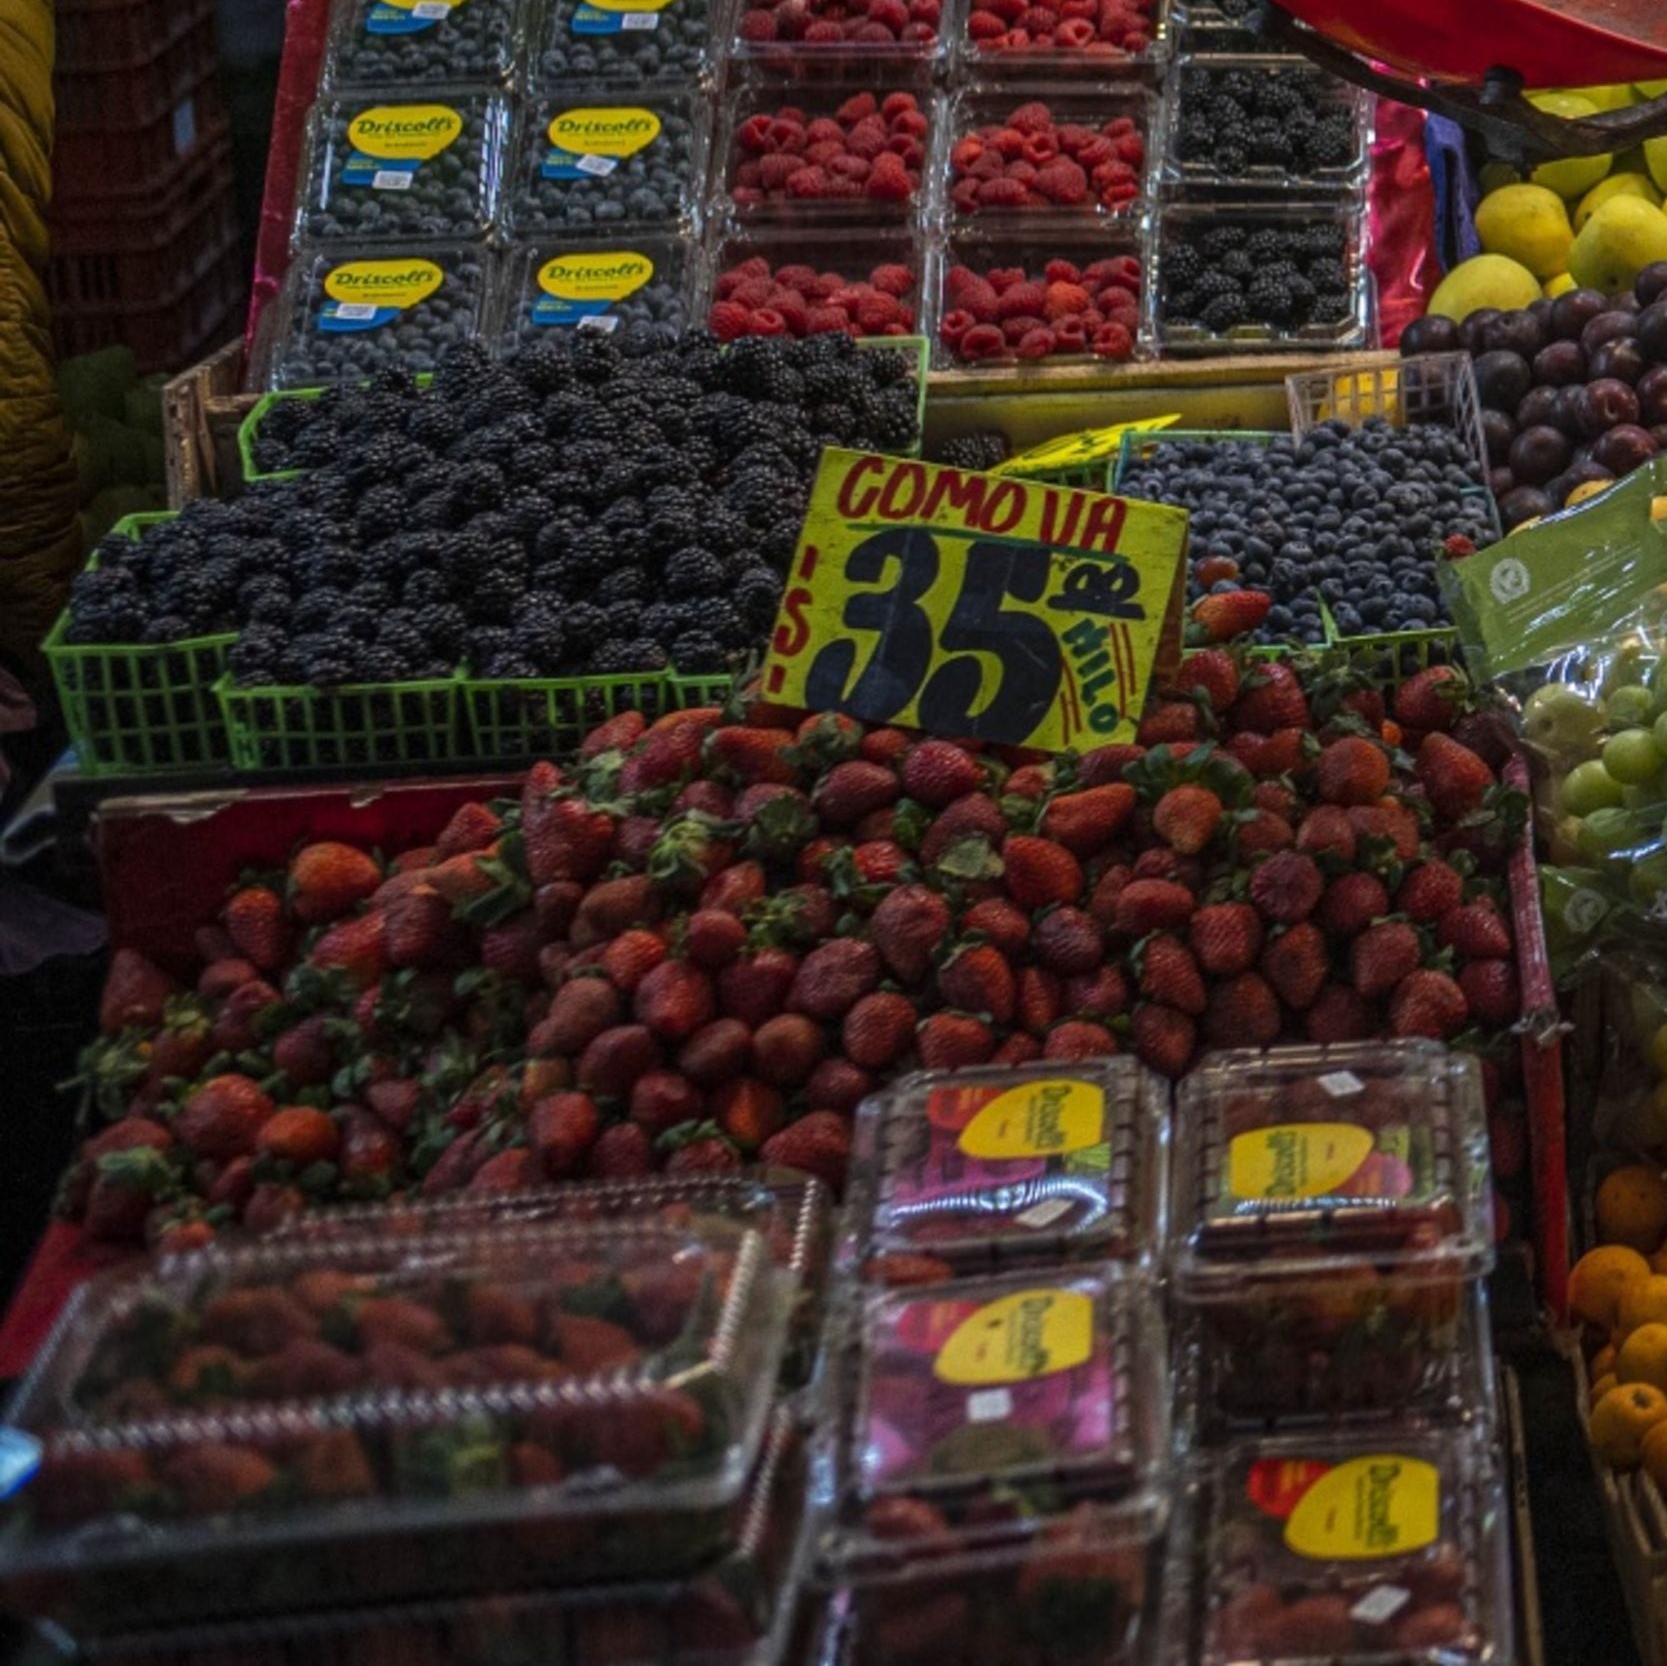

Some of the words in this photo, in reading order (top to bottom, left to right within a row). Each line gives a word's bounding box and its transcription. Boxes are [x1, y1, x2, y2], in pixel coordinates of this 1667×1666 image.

[357, 117, 455, 137] Driscoll's
[556, 117, 656, 136] Driscoll's
[333, 268, 437, 291] Driscoll's
[547, 263, 647, 284] Driscoll's
[1039, 491, 1128, 556] VA
[804, 522, 1064, 748] 35
[1060, 618, 1121, 735] KILO
